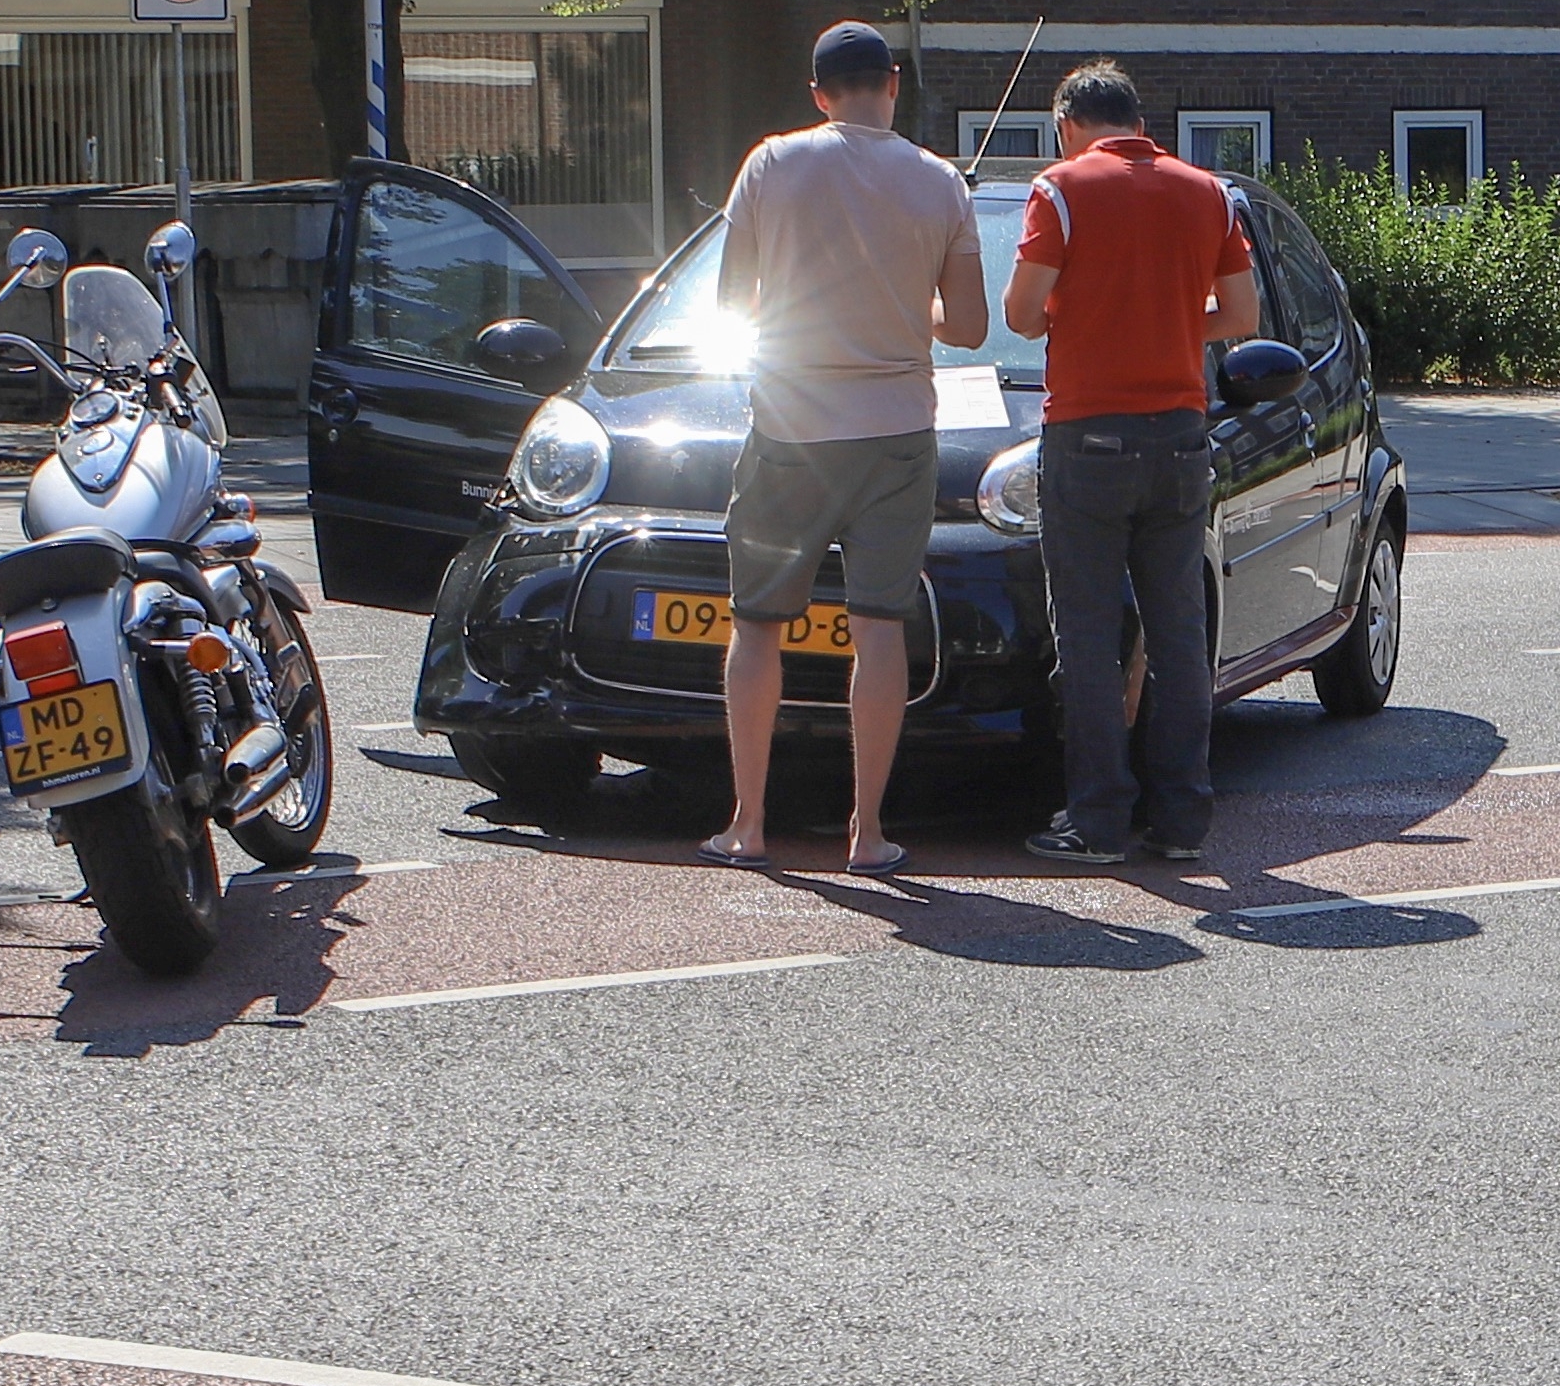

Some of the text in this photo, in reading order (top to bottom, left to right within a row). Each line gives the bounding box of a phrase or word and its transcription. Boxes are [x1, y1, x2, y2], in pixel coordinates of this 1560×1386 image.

[634, 621, 651, 632] NL
[665, 600, 852, 647] 09-D-8
[30, 696, 84, 735] MD
[13, 725, 114, 778] ZF-49
[42, 766, 101, 788] hhmotoren.nl
